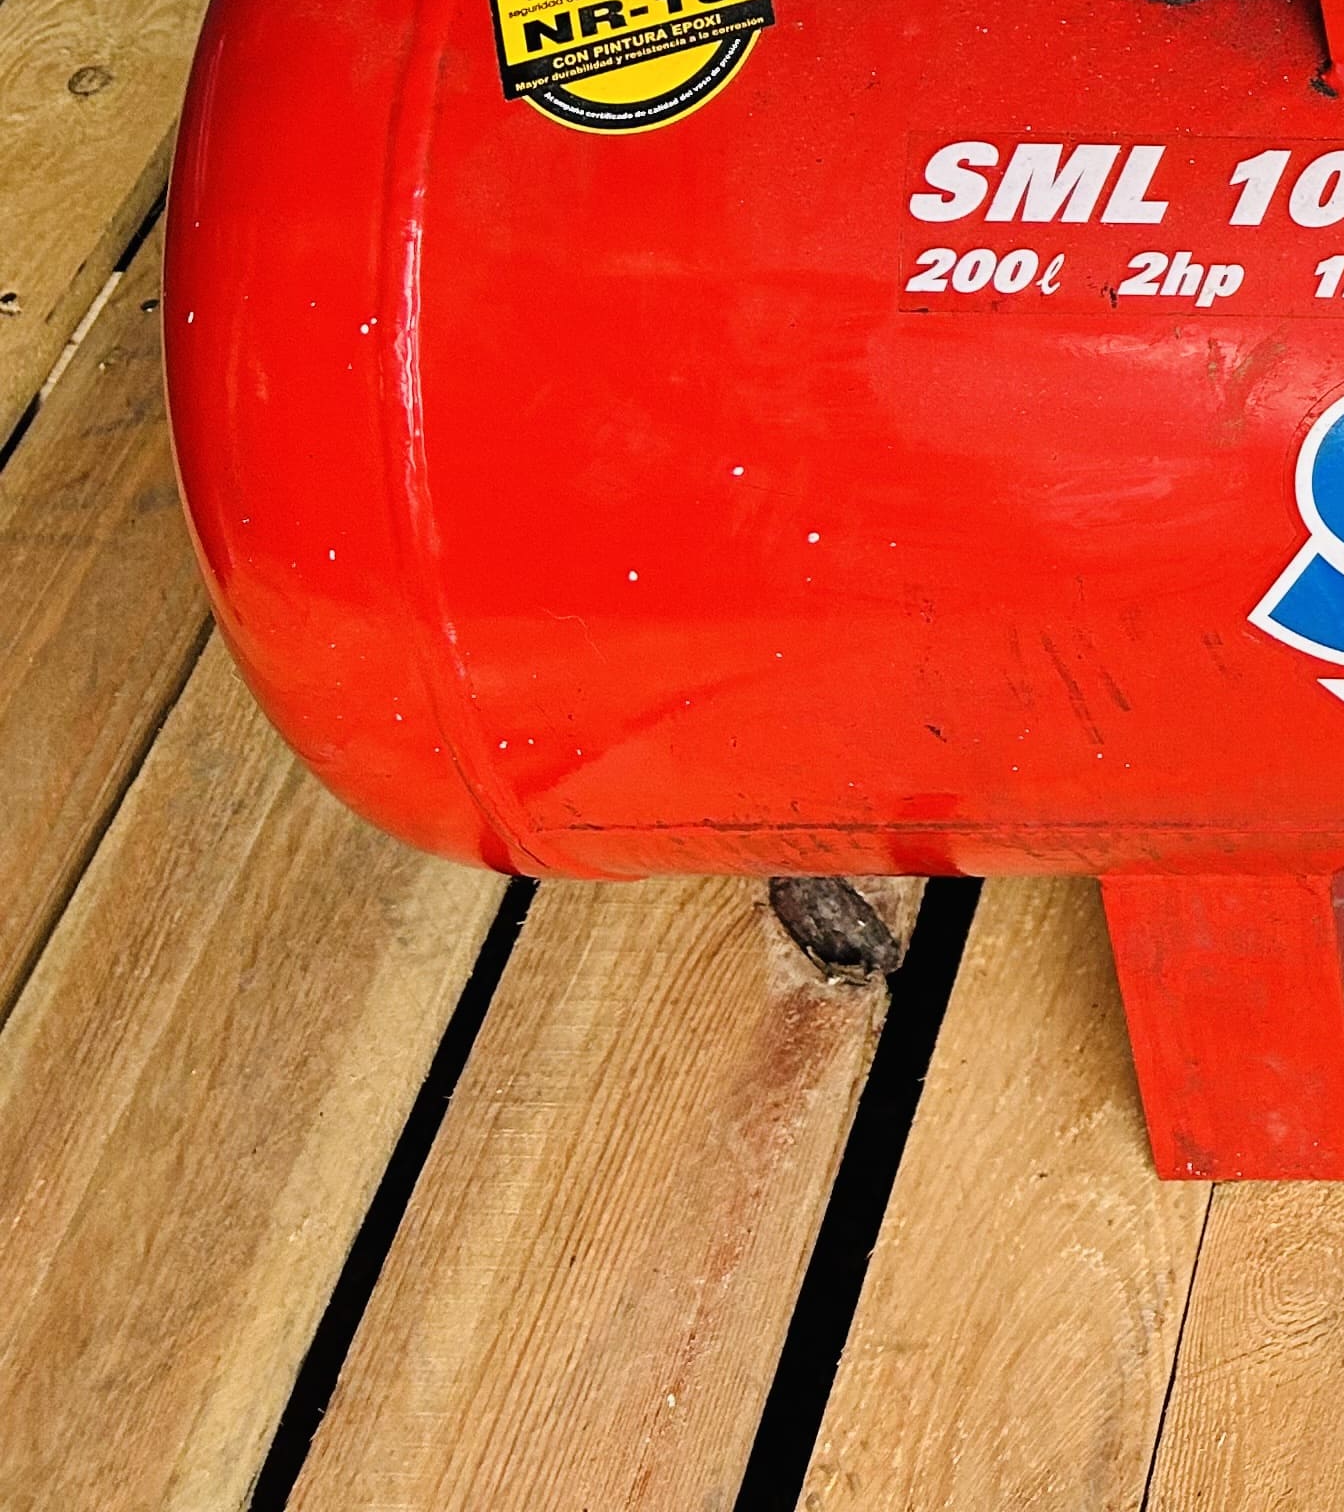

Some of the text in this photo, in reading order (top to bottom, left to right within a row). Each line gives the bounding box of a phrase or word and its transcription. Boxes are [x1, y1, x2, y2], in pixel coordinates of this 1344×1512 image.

[515, 76, 550, 92] Mayor
[551, 56, 613, 82] durabilidad
[624, 37, 687, 61] resistencia
[698, 30, 710, 40] la
[713, 16, 765, 36] corrosión
[552, 13, 722, 69] CON PINTURA EPOXI
[585, 109, 634, 120] certificado
[634, 110, 647, 118] de
[719, 38, 742, 68] presión
[909, 141, 1168, 224] SML
[1117, 251, 1245, 308] 2hp
